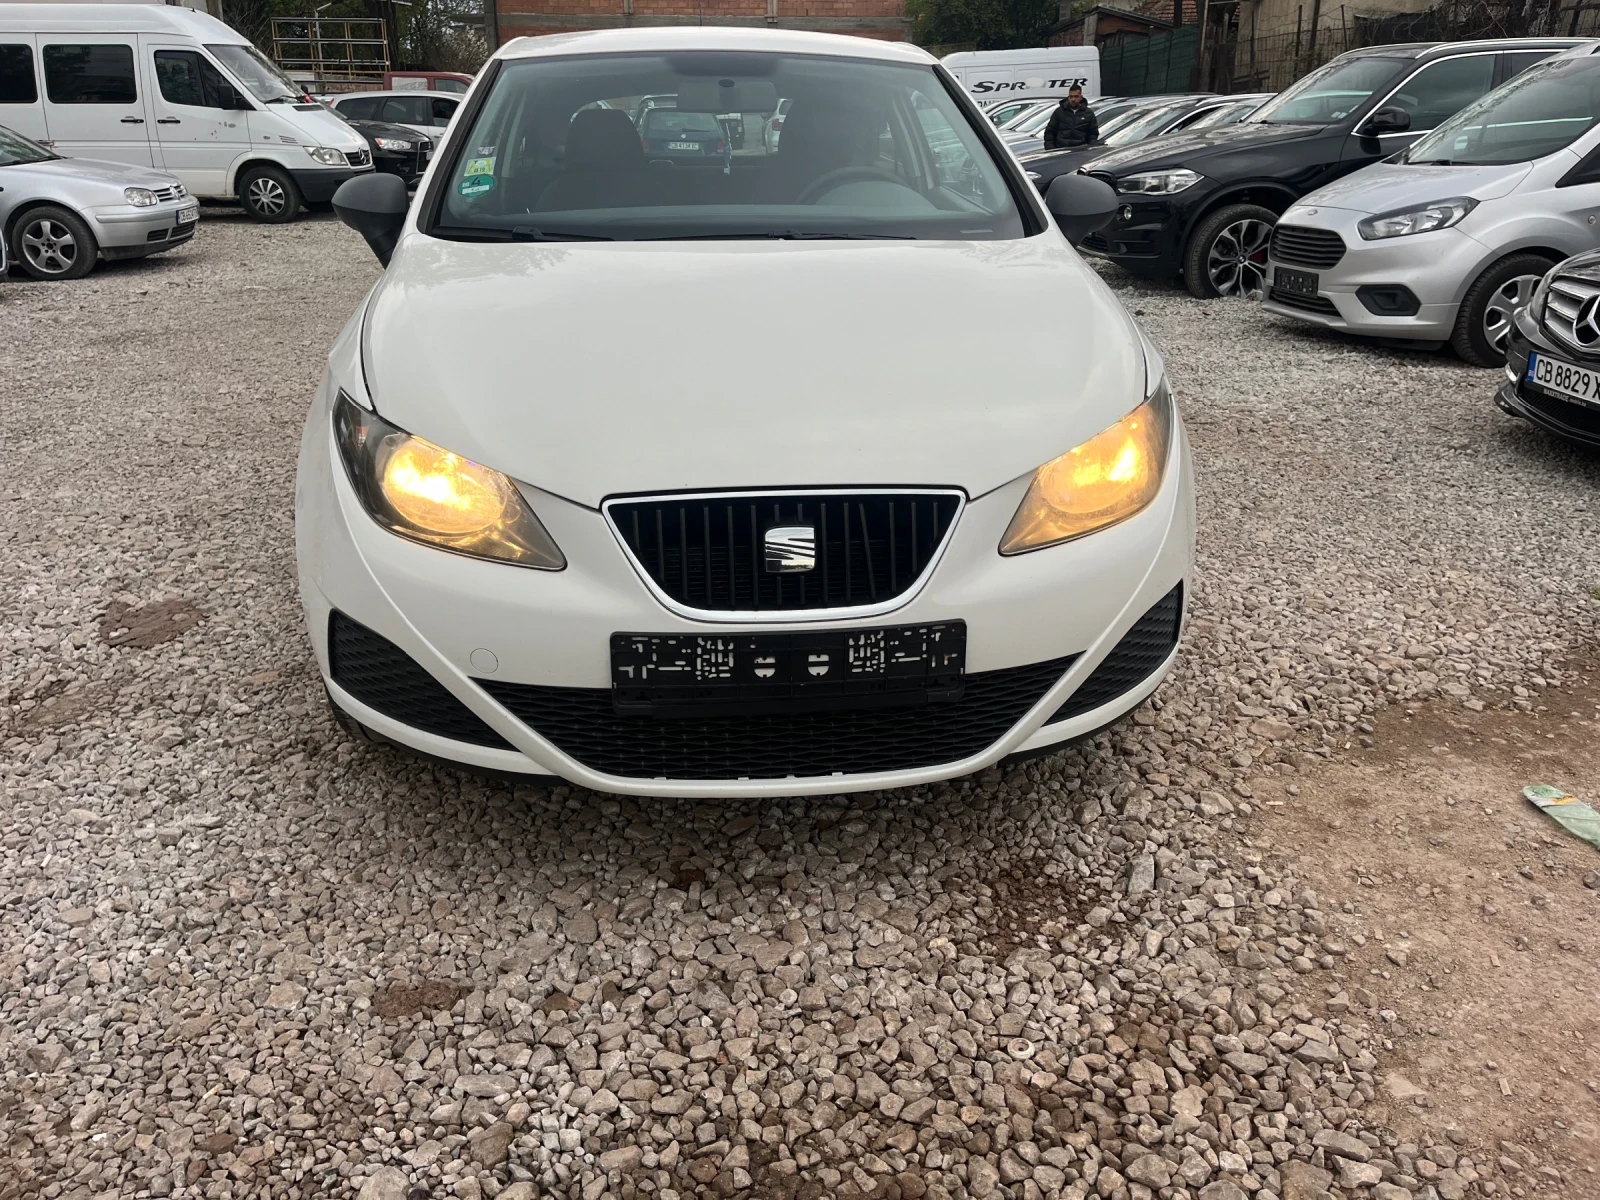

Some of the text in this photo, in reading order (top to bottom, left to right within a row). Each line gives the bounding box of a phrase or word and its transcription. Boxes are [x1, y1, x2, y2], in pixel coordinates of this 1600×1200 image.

[971, 77, 1088, 93] SPRTER
[1536, 359, 1553, 383] CB
[1555, 365, 1590, 395] 8829
